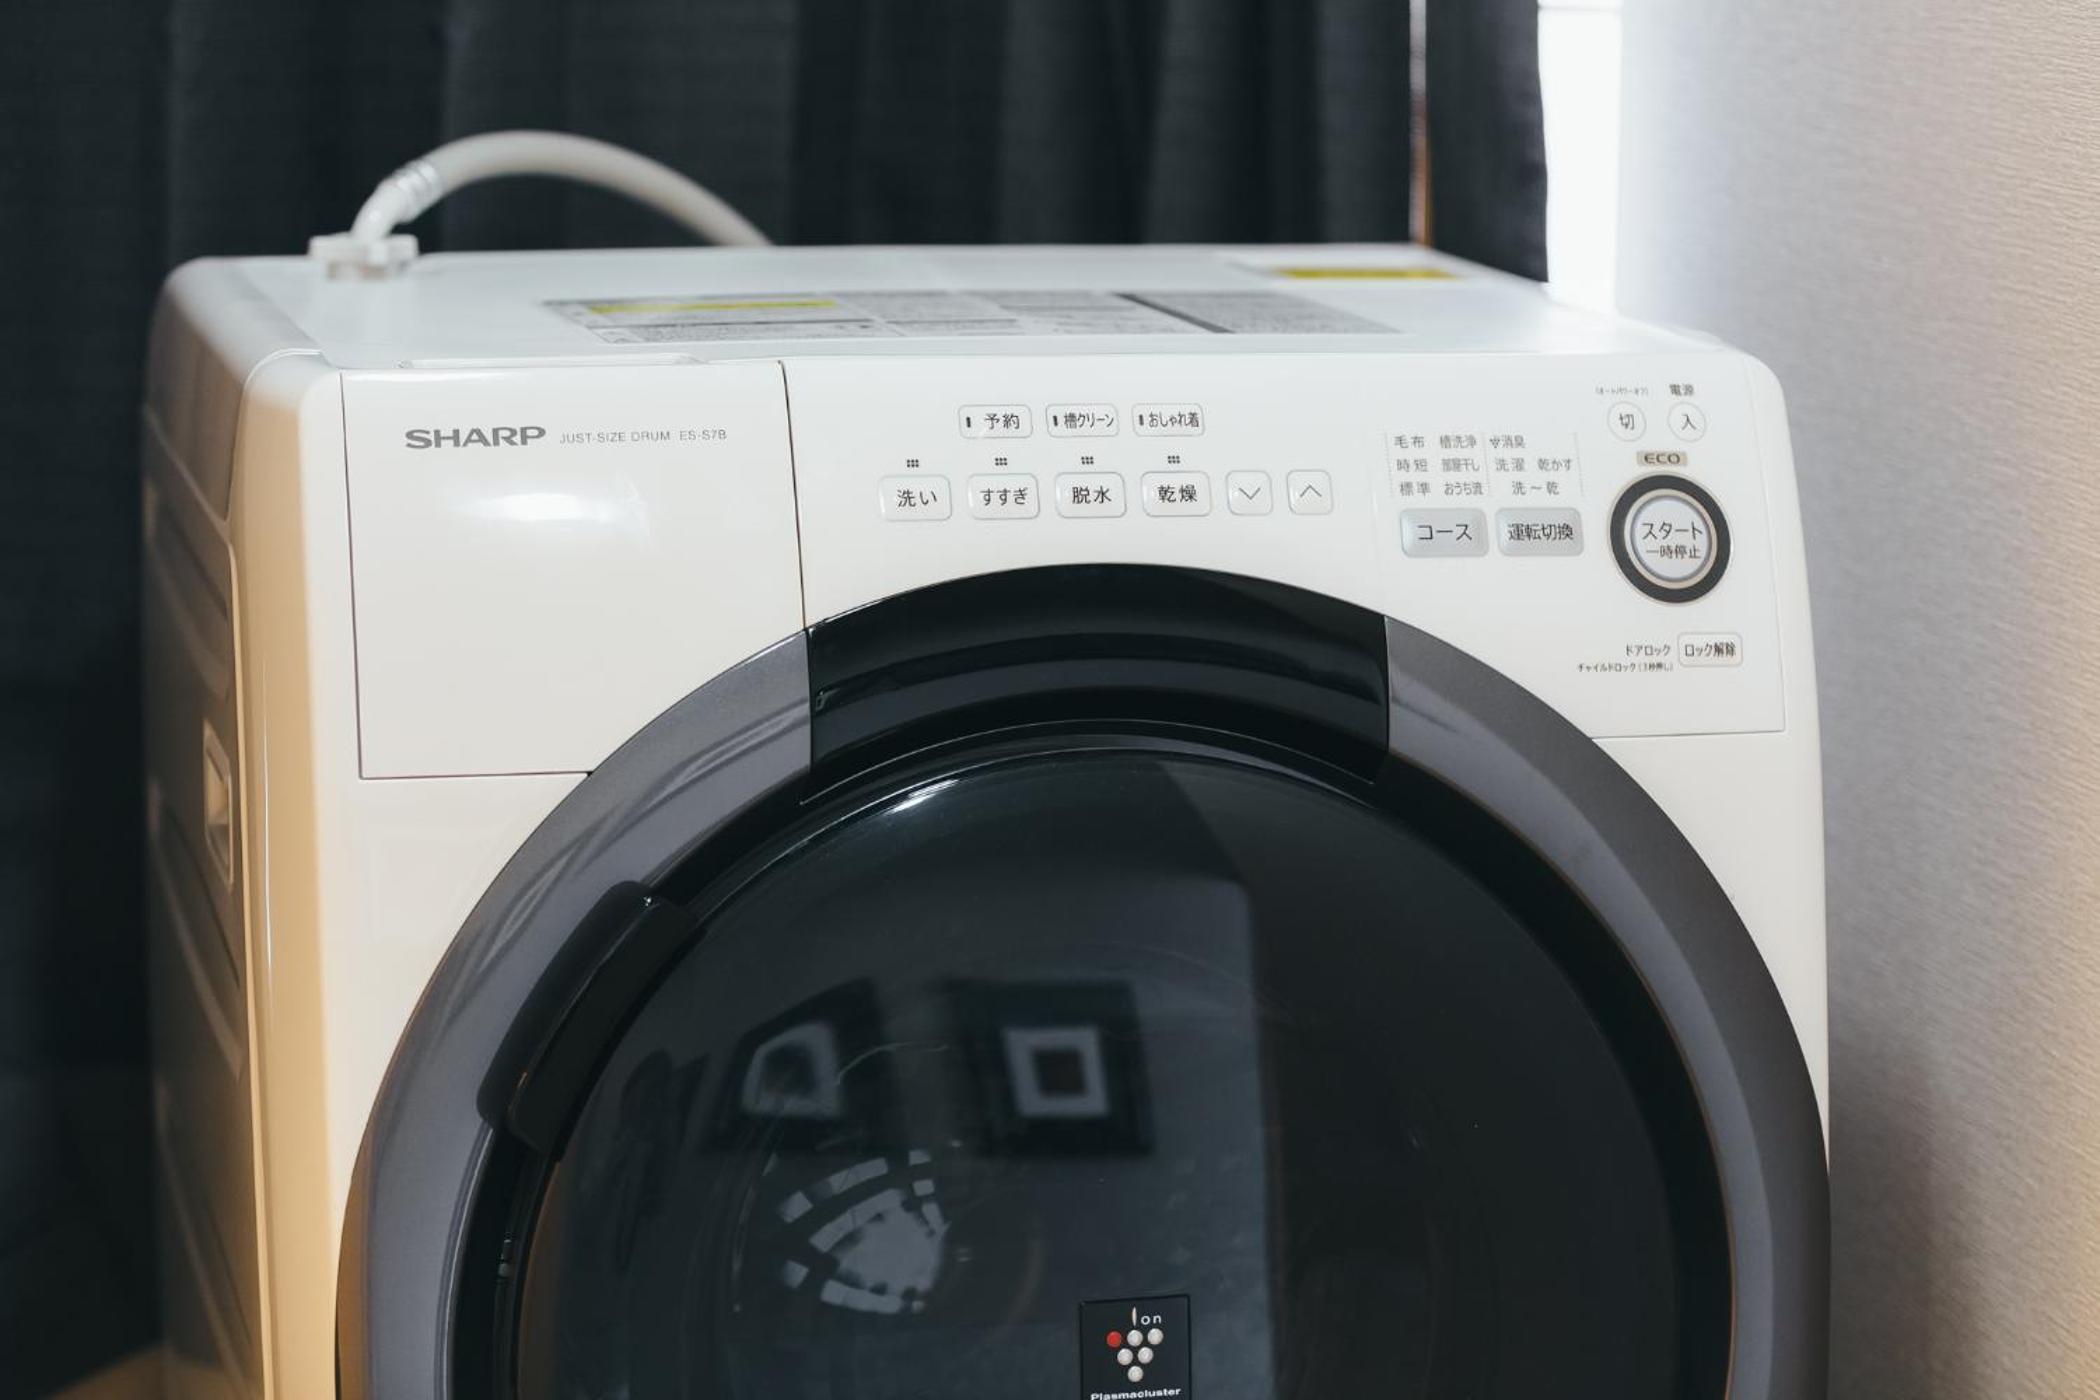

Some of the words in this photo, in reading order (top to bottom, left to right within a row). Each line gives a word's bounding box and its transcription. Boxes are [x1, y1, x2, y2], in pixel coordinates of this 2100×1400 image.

[984, 413, 1020, 430] 予約
[1063, 412, 1114, 429] 槽クリーン
[1149, 411, 1199, 428] おしゃれ着
[1619, 413, 1635, 431] 切
[1682, 414, 1697, 430] 入
[405, 426, 546, 449] SHARP
[560, 431, 626, 445] JUST-SIZE
[631, 431, 670, 442] DRUM
[1394, 434, 1424, 449] 毛布
[1396, 458, 1429, 473] 時短
[1495, 457, 1526, 472] 洗濯
[1537, 458, 1573, 472] 乾かす
[1644, 454, 1680, 464] ECO
[897, 489, 937, 507] 洗い
[980, 487, 1028, 506] すすぎ
[1072, 485, 1112, 504] 脱水
[1157, 484, 1197, 504] 乾燥
[1398, 481, 1431, 498] 標準
[1418, 524, 1472, 541] コース
[1508, 523, 1574, 541] 運転切換
[1642, 520, 1703, 540] スタート
[1646, 544, 1701, 559] 一時停止
[1626, 643, 1671, 657] ドアロック
[1685, 642, 1736, 658] ロック解除
[1091, 1388, 1181, 1400] Plasmacluster
